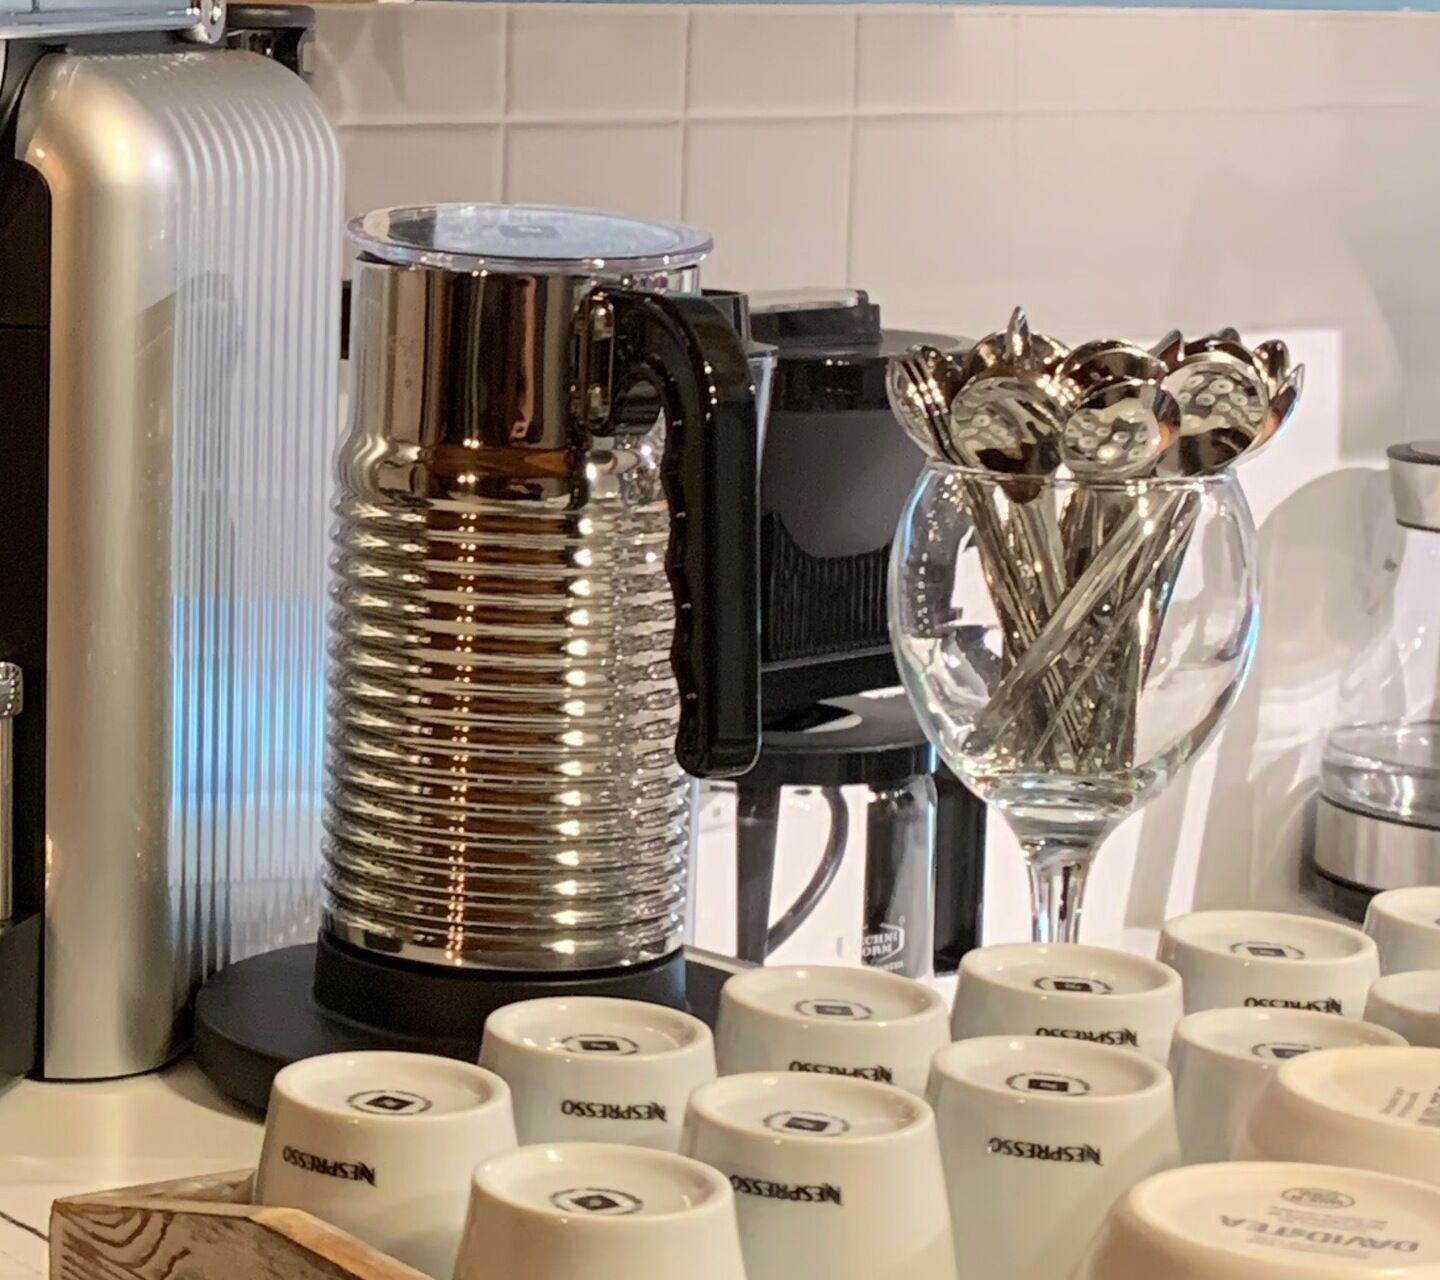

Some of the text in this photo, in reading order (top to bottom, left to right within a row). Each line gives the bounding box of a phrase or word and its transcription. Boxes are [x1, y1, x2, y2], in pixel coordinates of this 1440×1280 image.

[561, 1099, 668, 1123] NESPRESSO
[282, 1144, 377, 1188] NESPRESSO
[988, 1136, 1103, 1167] NESPRESSO
[729, 1173, 843, 1208] NESPRESSO
